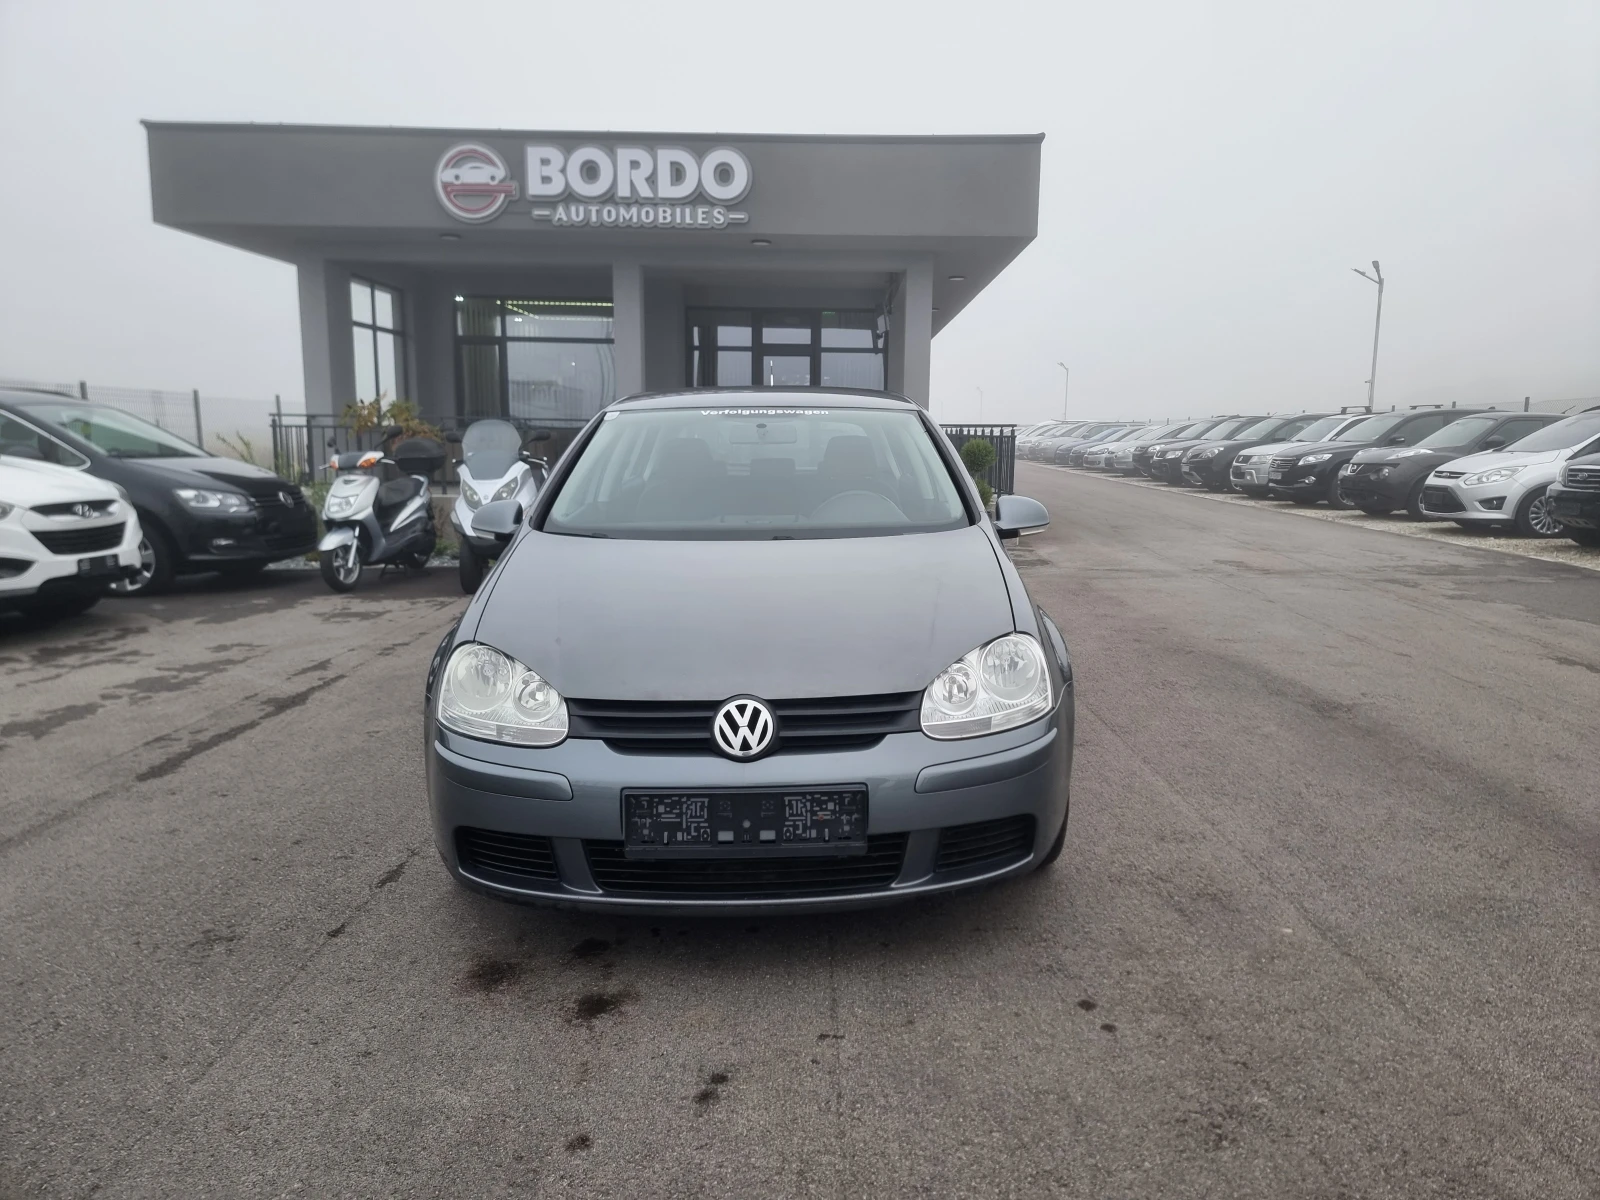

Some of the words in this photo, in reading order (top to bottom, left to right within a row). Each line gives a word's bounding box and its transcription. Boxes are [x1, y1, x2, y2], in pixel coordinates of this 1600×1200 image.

[526, 146, 749, 199] BORDO
[554, 205, 726, 225] AUTOMOBILES
[714, 699, 773, 756] VW
